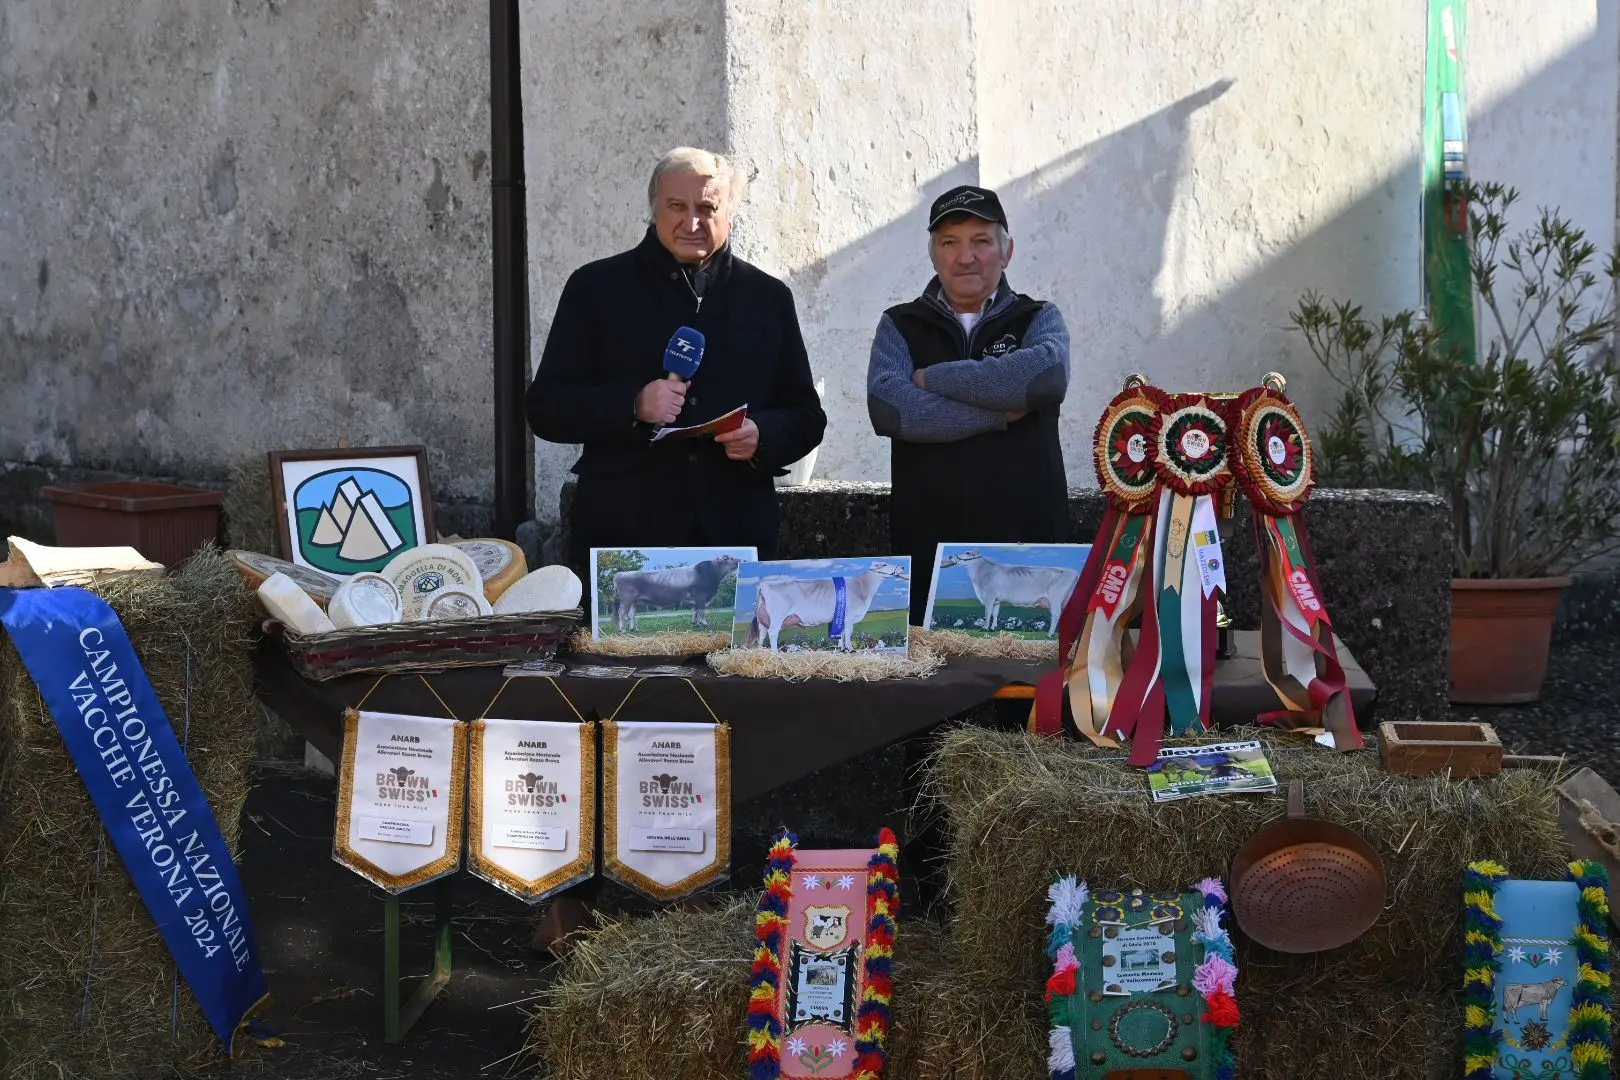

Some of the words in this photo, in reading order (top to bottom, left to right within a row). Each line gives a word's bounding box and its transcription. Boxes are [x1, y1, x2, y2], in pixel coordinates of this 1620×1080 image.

[437, 563, 447, 571] DI
[446, 568, 464, 585] MONT
[1100, 565, 1127, 604] CMP
[1291, 571, 1321, 610] CMP
[390, 734, 420, 744] ANARB
[518, 740, 547, 749] ANARB
[652, 741, 682, 749] ANARB
[1157, 742, 1257, 756] llevatori
[78, 627, 188, 823] CAMPIONESSA
[176, 829, 250, 973] NAZIONALE
[378, 788, 426, 803] SWISS
[507, 793, 554, 808] SWISS
[642, 794, 689, 809] SWISS
[67, 670, 136, 789] VACCHE
[125, 790, 195, 906] VERONA
[183, 908, 224, 959] 2024
